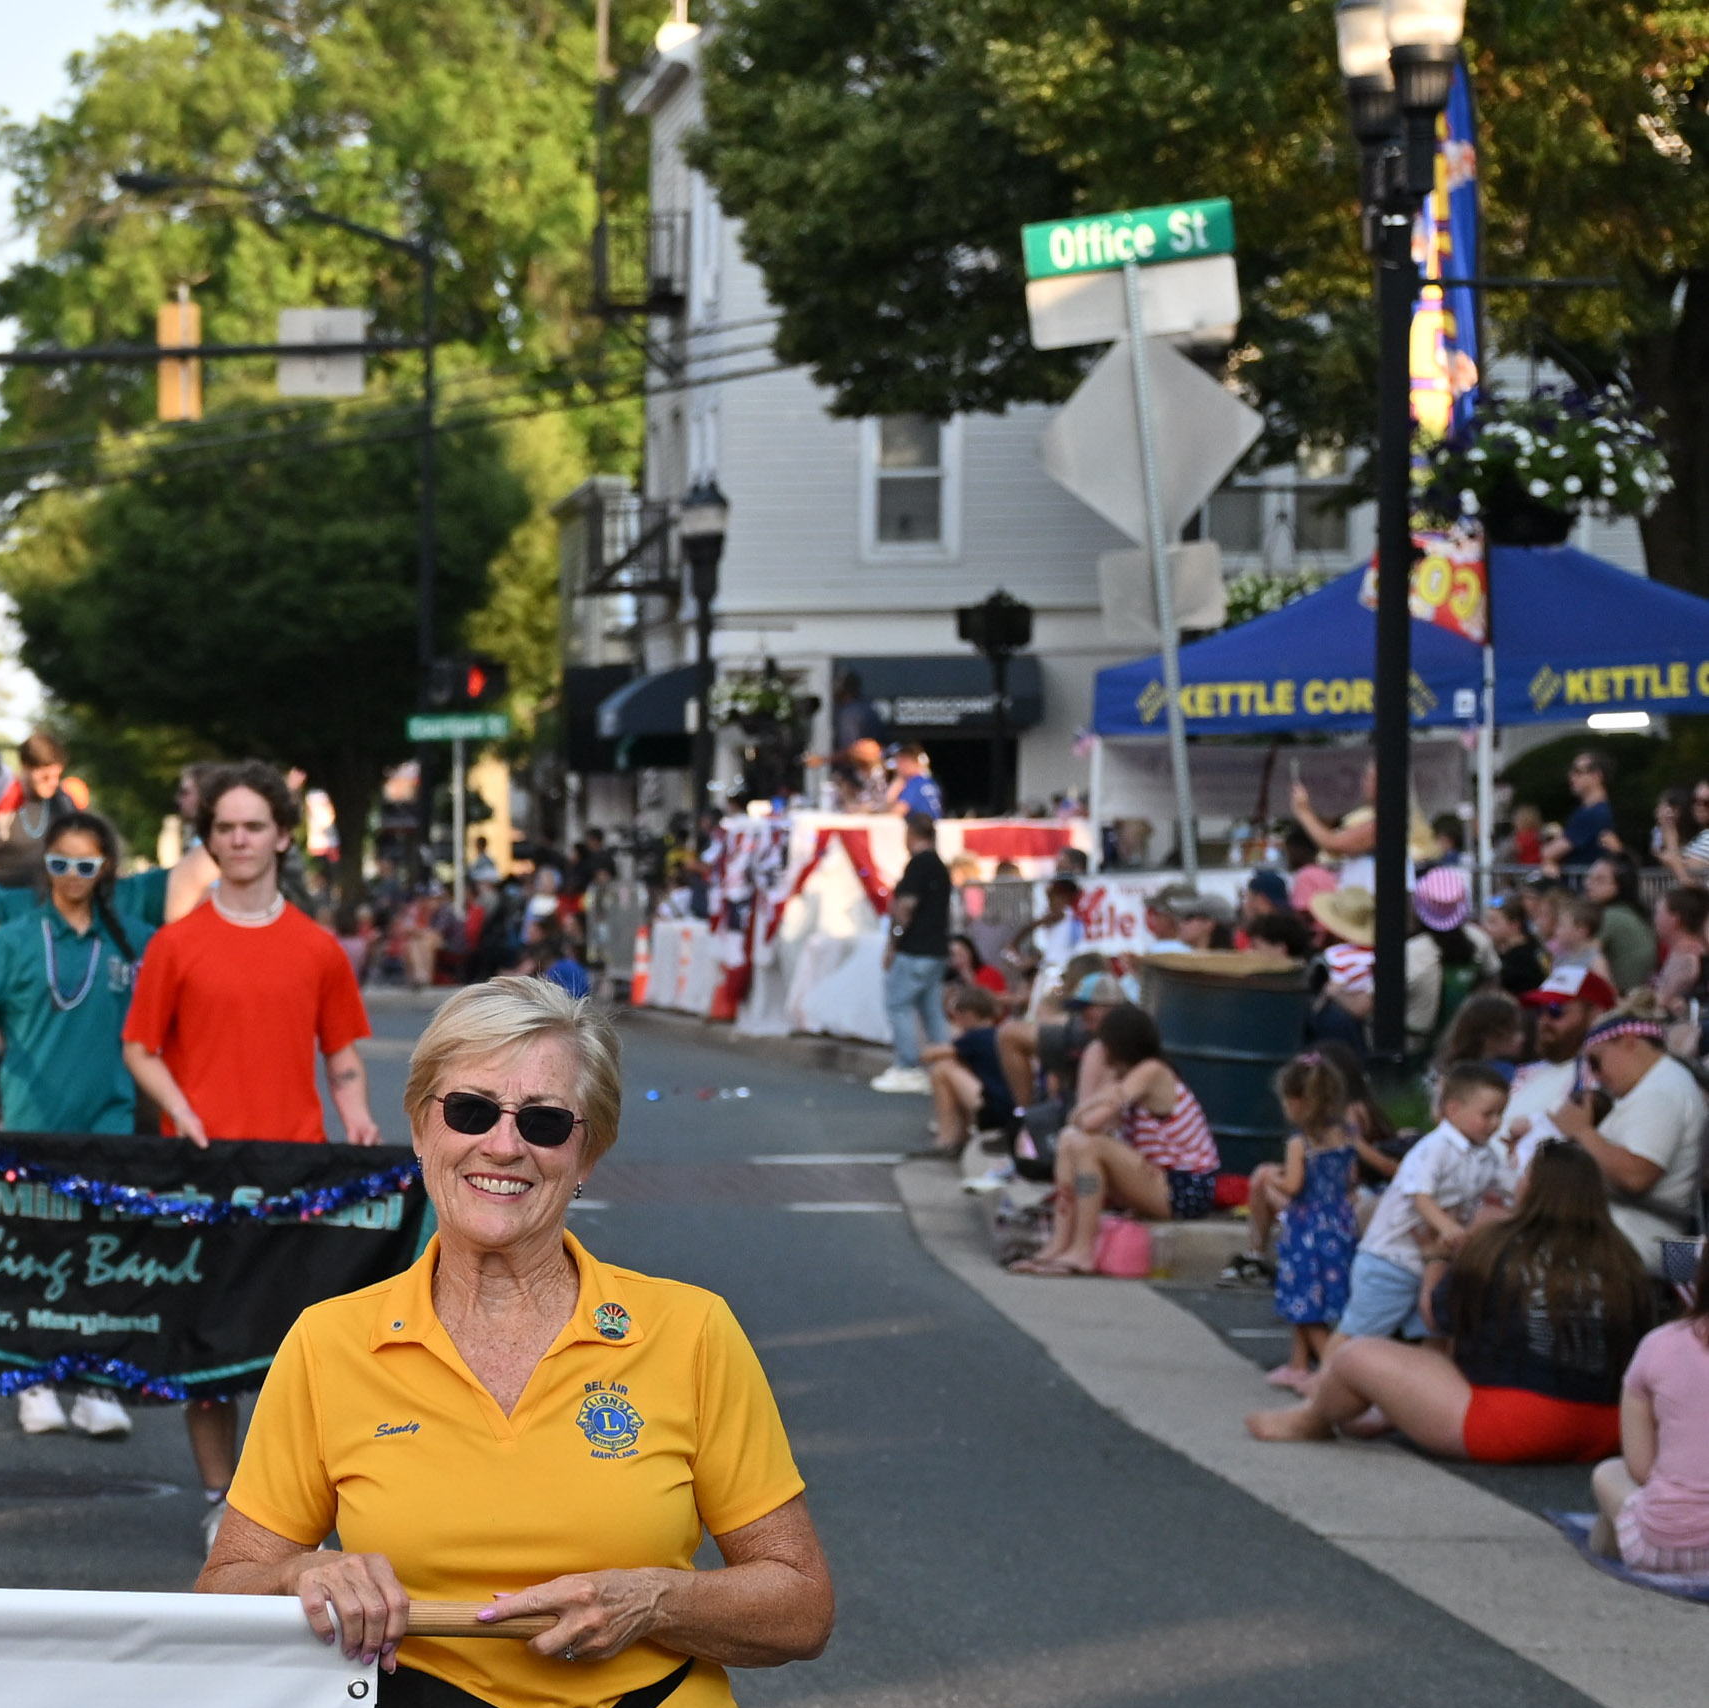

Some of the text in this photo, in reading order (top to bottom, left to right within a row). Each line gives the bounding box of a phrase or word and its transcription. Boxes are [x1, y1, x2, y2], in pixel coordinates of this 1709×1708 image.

[1049, 209, 1211, 270] Office St
[1564, 661, 1690, 705] KETTLE
[1179, 680, 1296, 718] KETTLE
[1303, 679, 1375, 715] COR
[84, 1233, 203, 1287] Band
[27, 1308, 160, 1336] Maryland
[584, 1381, 628, 1395] BEL AIR
[588, 1396, 627, 1410] LIONS
[374, 1420, 421, 1438] Sandy
[601, 1412, 620, 1431] L
[591, 1449, 639, 1460] MARYLAND
